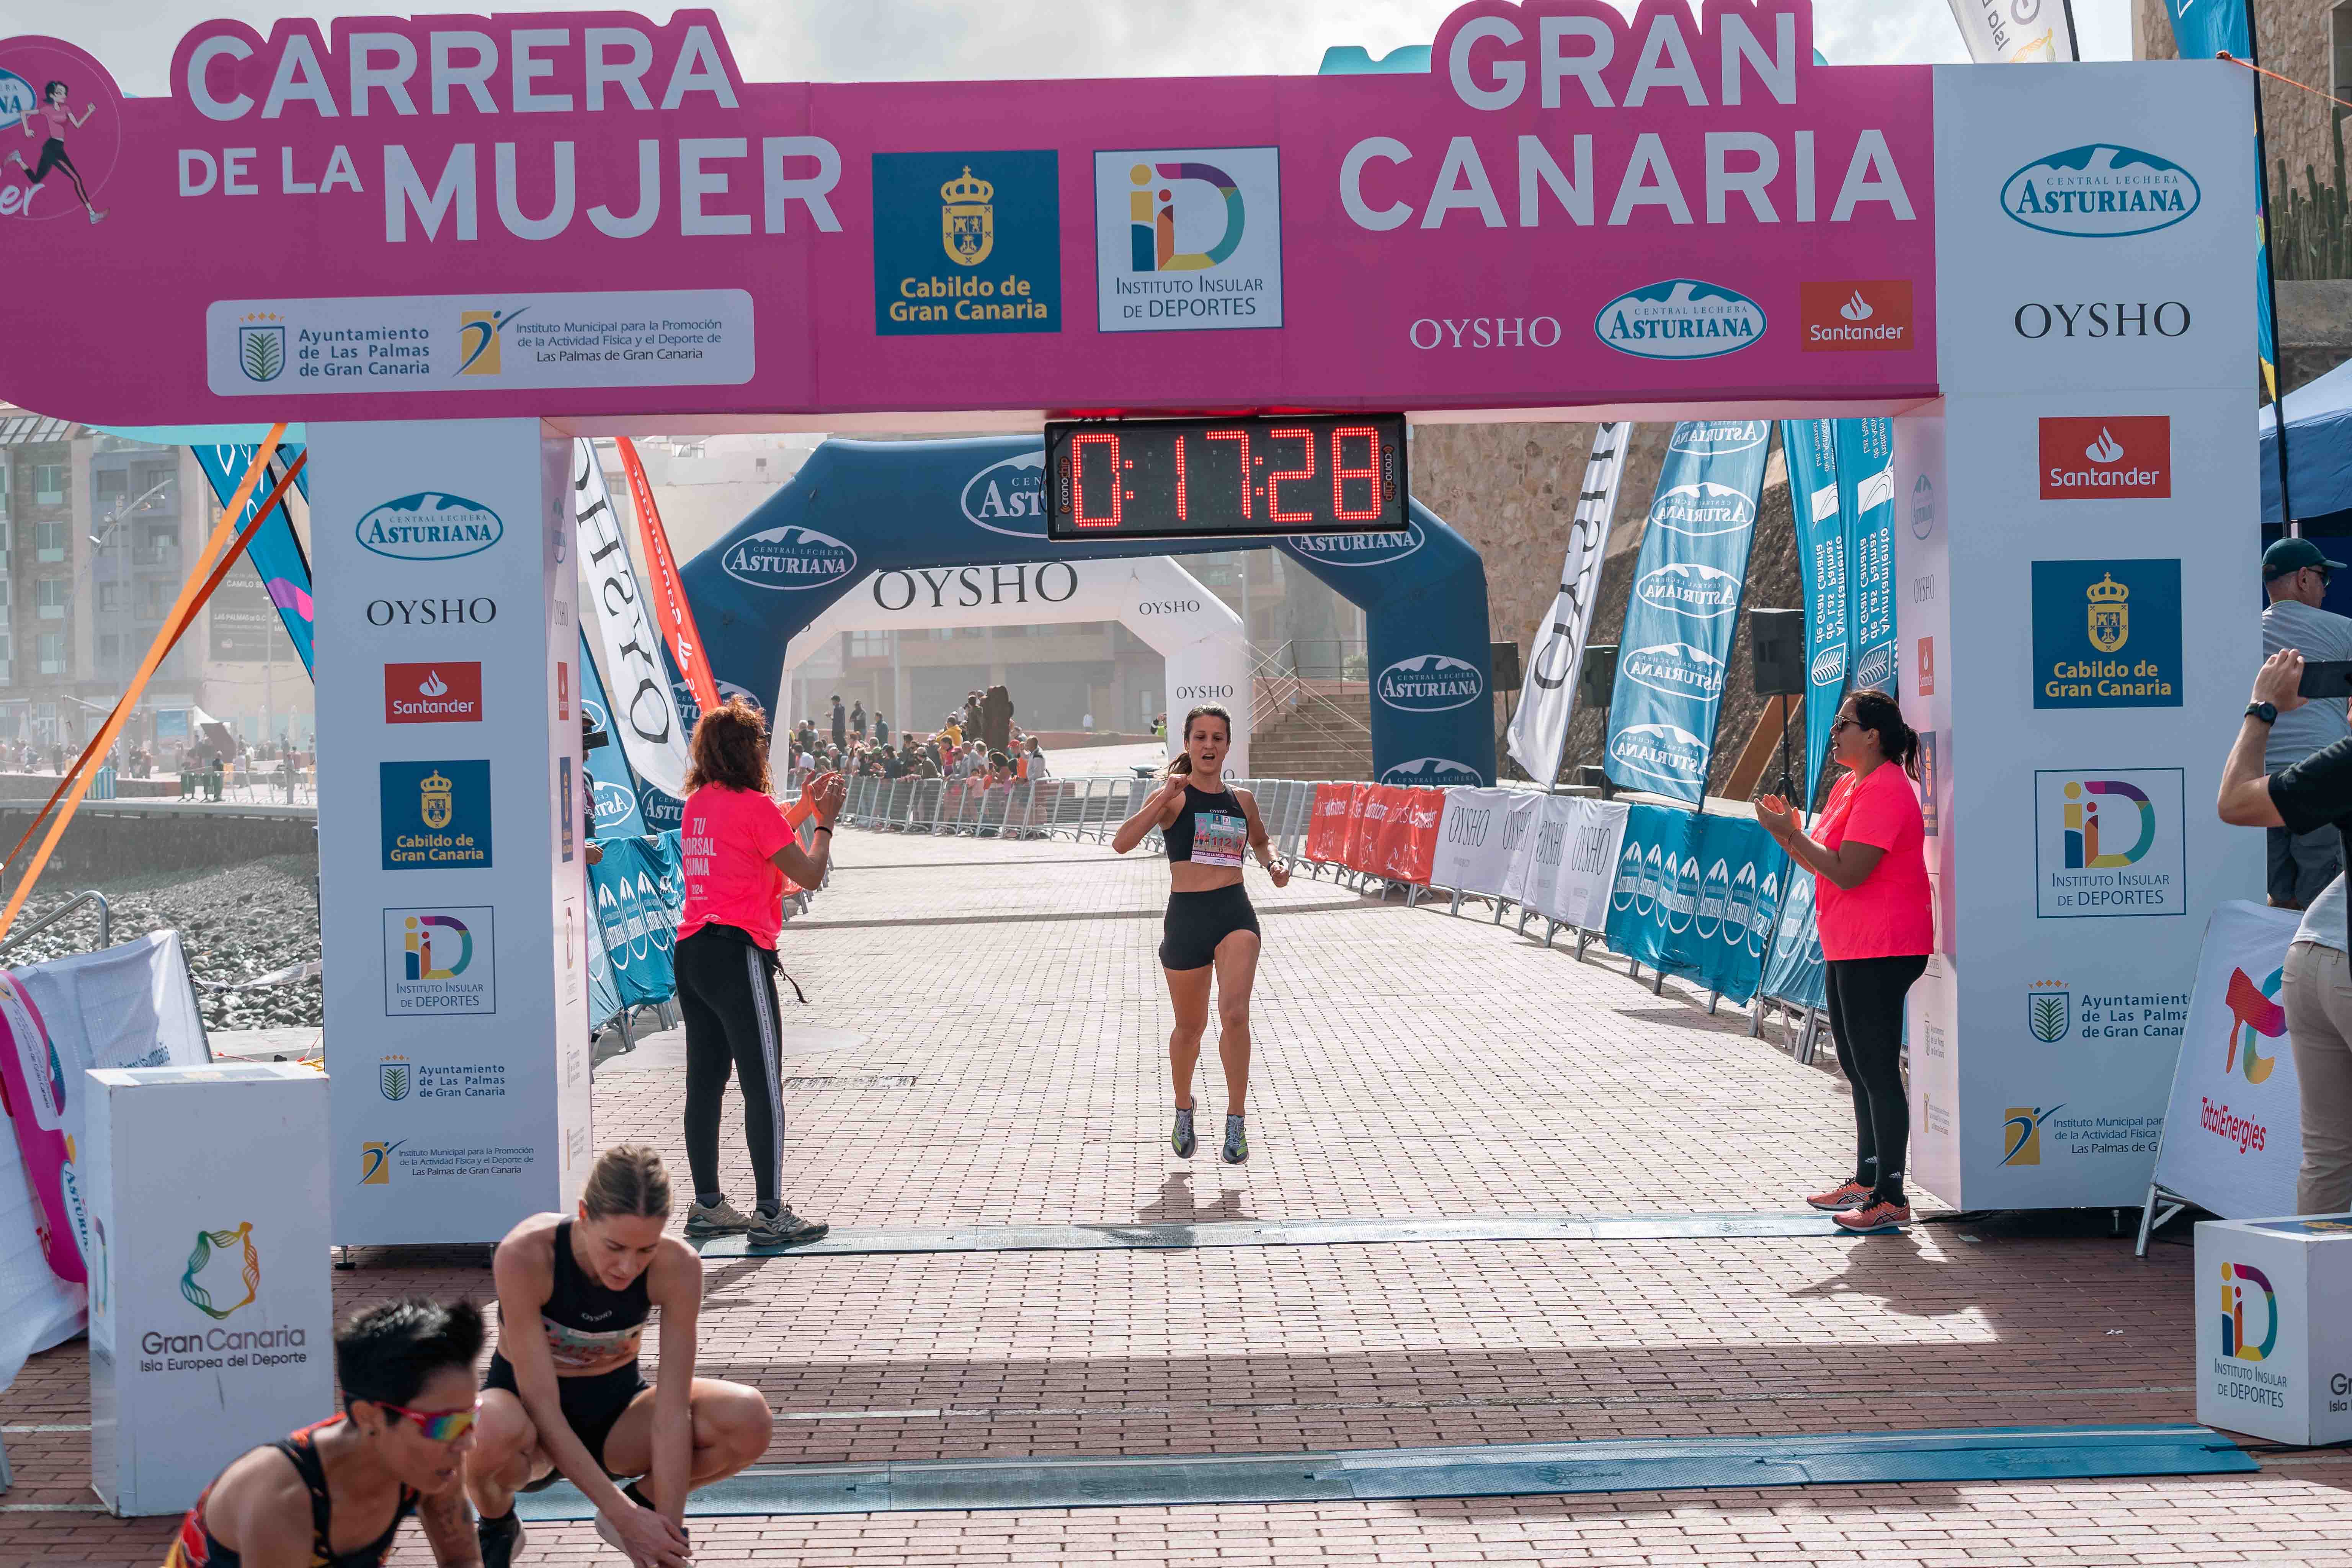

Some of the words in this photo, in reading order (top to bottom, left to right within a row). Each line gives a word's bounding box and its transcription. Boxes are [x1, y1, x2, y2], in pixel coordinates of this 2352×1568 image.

[1449, 13, 1796, 110] GRAN
[187, 25, 740, 121] CARRERA
[1340, 129, 1917, 231] CANARIA
[2047, 176, 2110, 186] CENTRAL
[2116, 175, 2178, 185] LECHERA
[178, 147, 258, 196] DE
[282, 145, 364, 194] LA
[384, 136, 843, 243] MUJER
[2017, 180, 2185, 213] ASTURIANA
[900, 276, 994, 298] Cabildo
[1001, 276, 1030, 296] de
[1116, 276, 1193, 294] INSTITUTO
[1199, 274, 1263, 292] INSULAR
[890, 302, 948, 322] Gran
[955, 299, 1047, 320] Canaria
[1124, 304, 1143, 318] DE
[1149, 298, 1256, 317] DEPORTES
[1635, 307, 1688, 316] CENTRAL
[1694, 305, 1748, 314] LECHERA
[516, 323, 560, 333] Instituto
[565, 322, 617, 333] Municipal
[621, 320, 645, 333] para
[650, 320, 658, 330] la
[663, 320, 722, 330] Promoción
[1609, 310, 1753, 341] ASTURIANA
[2014, 302, 2190, 338] OYSHO
[299, 327, 429, 343] Ayuntamiento
[518, 337, 532, 346] de
[536, 336, 544, 346] la
[549, 335, 599, 346] Actividad
[635, 336, 642, 347] y
[646, 335, 654, 344] el
[659, 335, 703, 346] Deporte
[707, 333, 721, 343] de
[1410, 316, 1561, 349] OYSHO
[1810, 324, 1904, 342] Santander
[299, 346, 319, 359] de
[331, 345, 358, 359] Las
[369, 343, 429, 358] Palmas
[537, 351, 555, 362] Las
[560, 350, 600, 361] Palmas
[604, 350, 620, 360] de
[623, 350, 653, 360] Gran
[657, 348, 703, 359] Canaria
[299, 363, 319, 376] de
[324, 363, 363, 376] Gran
[369, 361, 430, 375] Canaria
[2050, 468, 2159, 487] Santander
[368, 518, 492, 543] ASTURIANA
[753, 546, 796, 555] CENTRAL
[732, 548, 846, 575] ASTURIANA
[873, 562, 1078, 610] OYSHO
[367, 598, 497, 626] OYSHO
[1139, 600, 1200, 615] OYSHO
[2053, 661, 2128, 678] Cabildo
[2134, 660, 2158, 677] de
[1177, 686, 1233, 699] OYSHO
[1383, 676, 1477, 697] ASTURIANA
[2045, 682, 2094, 697] Gran
[2097, 679, 2171, 696] Canaria
[393, 700, 474, 715] Santander
[693, 817, 706, 835] TU
[1449, 806, 1490, 847] OYSHO
[397, 835, 451, 848] Cabildo
[456, 835, 474, 846] de
[390, 849, 426, 861] Gran
[429, 848, 484, 861] Canaria
[2051, 872, 2113, 887] INSTITUTO
[2118, 871, 2169, 885] INSULAR
[2057, 894, 2073, 906] DE
[2078, 890, 2163, 906] DEPORTES
[396, 983, 442, 994] INSTITUTO
[445, 982, 483, 993] INSULAR
[401, 999, 412, 1008] DE
[415, 995, 479, 1007] DEPORTES
[2082, 993, 2190, 1007] Ayuntamient
[2082, 1011, 2100, 1022] de
[2110, 1009, 2134, 1021] Las
[2144, 1008, 2187, 1021] Palma
[2082, 1027, 2099, 1038] de
[2104, 1026, 2138, 1037] Gran
[419, 1064, 505, 1076] Ayuntamiento
[420, 1077, 433, 1086] de
[440, 1077, 458, 1085] Las
[466, 1076, 505, 1085] Palmas
[420, 1088, 433, 1097] de
[436, 1088, 461, 1096] Gran
[465, 1087, 505, 1096] Canaria
[2054, 1119, 2092, 1127] Instituto
[2096, 1117, 2143, 1127] Municipal
[2200, 1097, 2266, 1155] TotalEnergies
[2055, 1131, 2067, 1139] de
[2071, 1131, 2078, 1139] la
[2082, 1130, 2127, 1139] Actividad
[2072, 1144, 2088, 1153] Las
[2092, 1143, 2128, 1153] Palmas
[2132, 1143, 2145, 1152] de
[141, 1360, 163, 1372] Isla
[168, 1358, 223, 1371] Europea
[227, 1355, 248, 1367] del
[253, 1352, 306, 1367] Deporte
[2215, 1358, 2252, 1380] INSTITUTO
[2255, 1366, 2287, 1388] INSULAR
[2218, 1383, 2228, 1396] DE
[2231, 1382, 2283, 1408] DEPORTES
[2330, 1400, 2347, 1412] Isla
